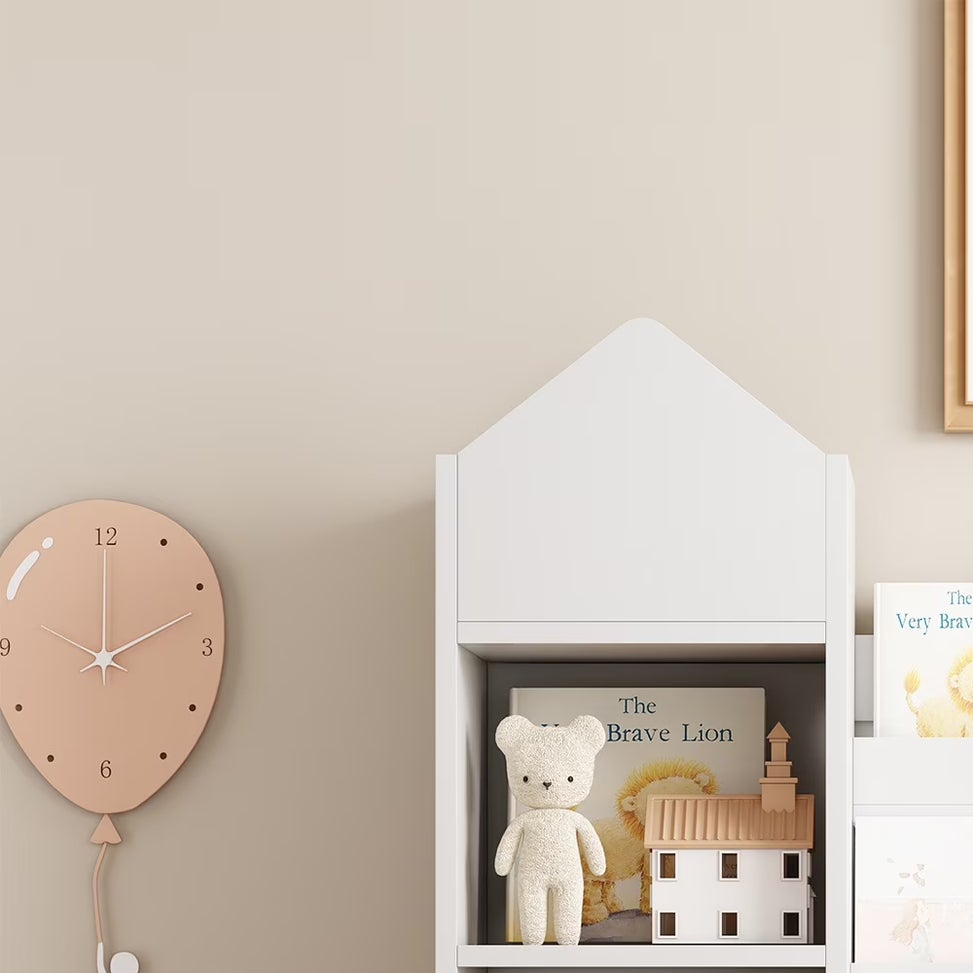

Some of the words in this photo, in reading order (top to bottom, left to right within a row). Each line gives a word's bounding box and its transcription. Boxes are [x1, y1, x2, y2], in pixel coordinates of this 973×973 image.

[95, 527, 117, 546] 12
[947, 590, 972, 605] The
[896, 613, 931, 635] Very
[0, 638, 11, 656] 9
[202, 638, 213, 656] 3
[618, 696, 657, 714] The
[607, 724, 670, 743] Brave
[682, 723, 734, 743] Lion
[100, 760, 112, 778] 6
